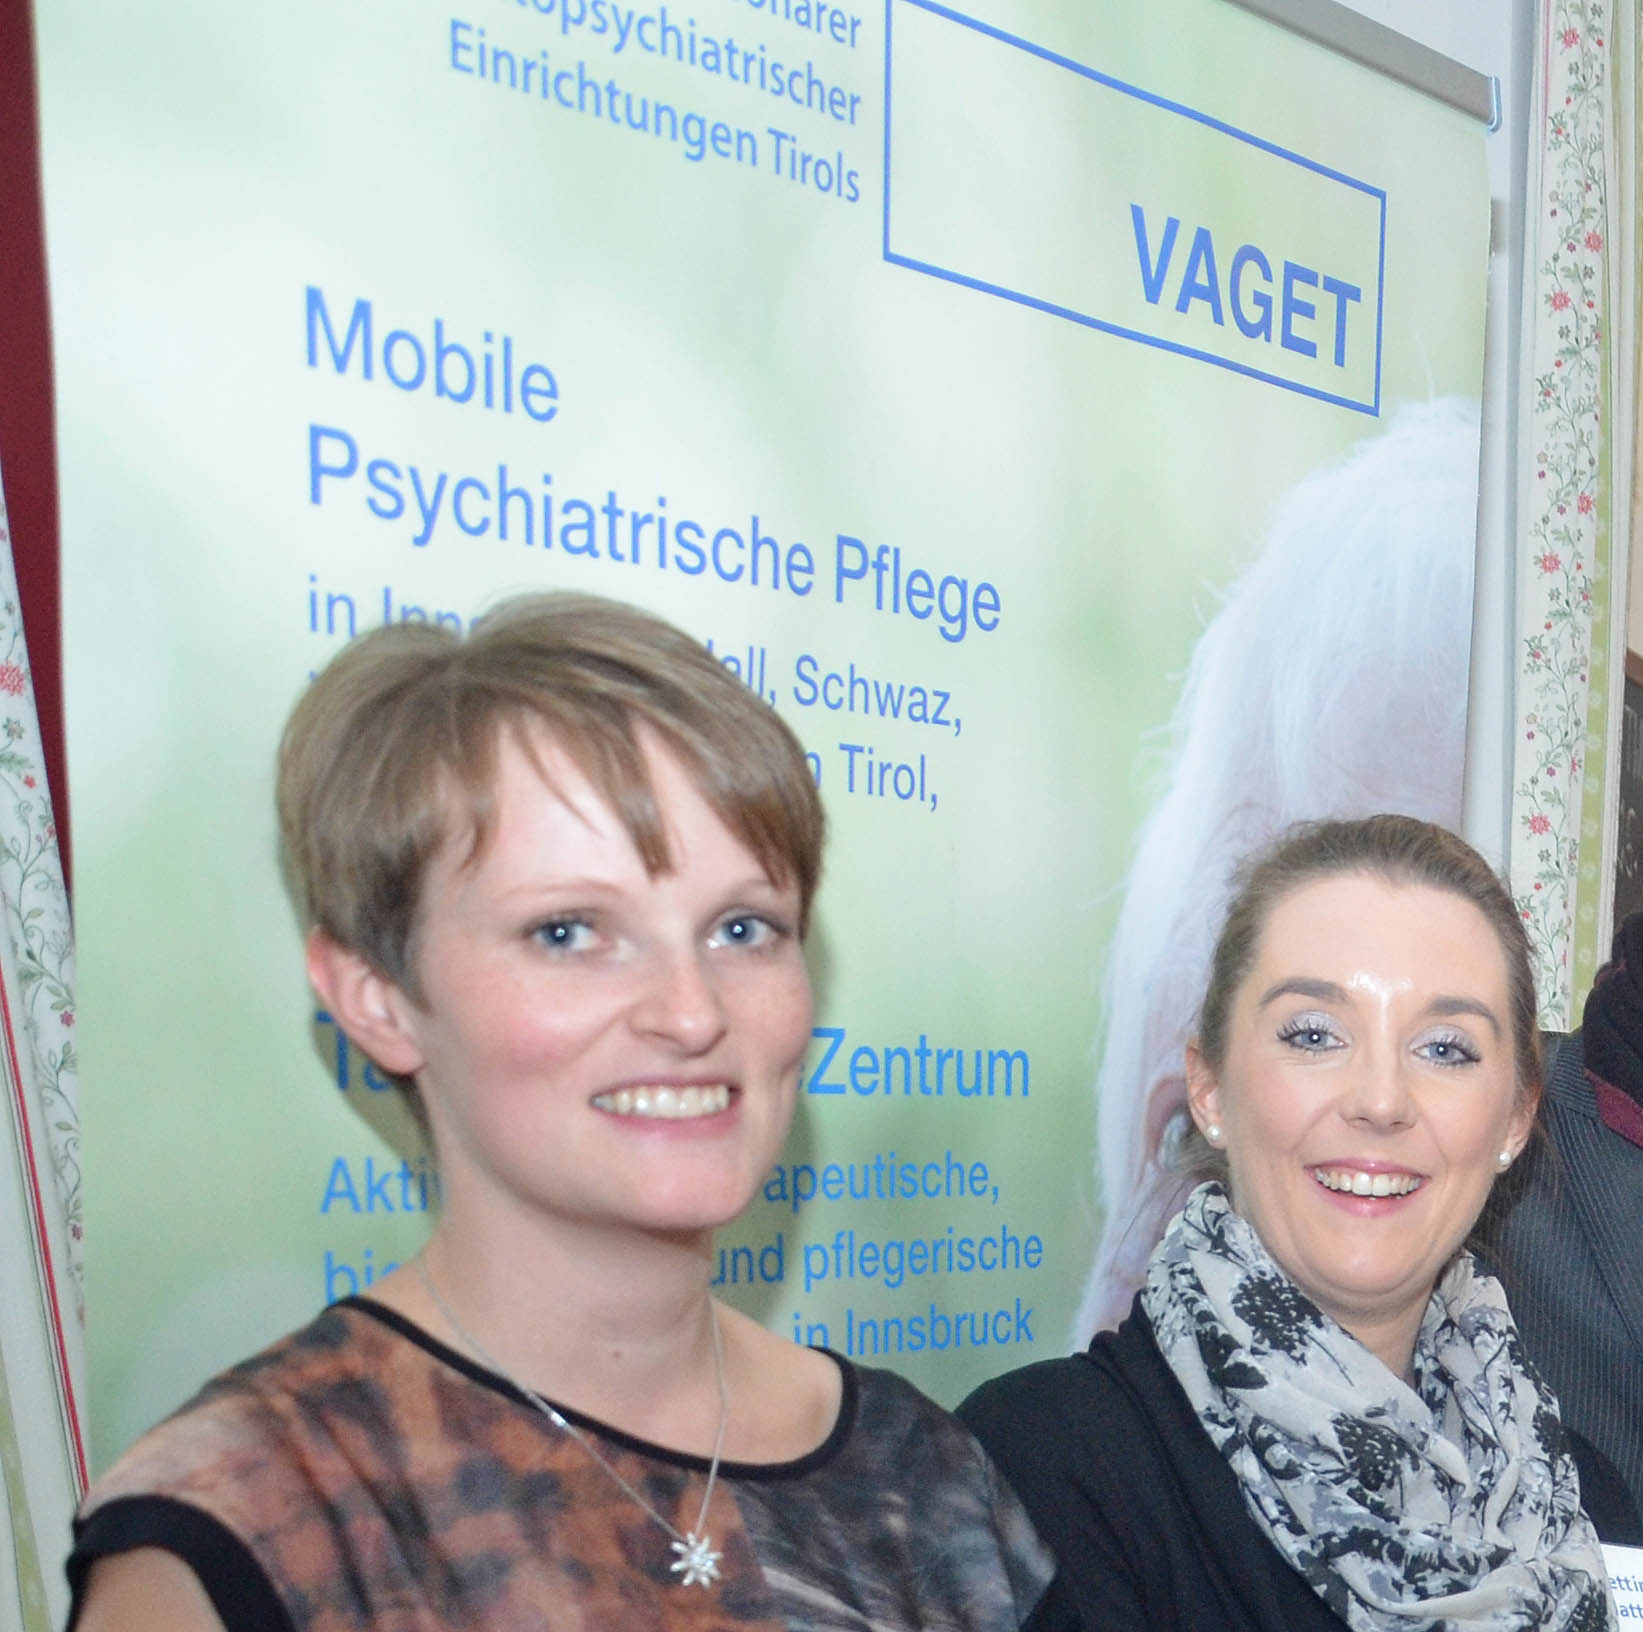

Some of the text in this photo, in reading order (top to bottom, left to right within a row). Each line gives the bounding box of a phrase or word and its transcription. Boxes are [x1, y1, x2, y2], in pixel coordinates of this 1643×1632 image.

[449, 17, 860, 203] Einrichtungen Tirols
[1129, 202, 1362, 368] VAGET
[306, 284, 559, 423] Mobile
[308, 422, 1001, 644] Psychiatrische Pflege
[308, 573, 357, 639] in
[793, 654, 963, 737] Schwaz,
[838, 742, 938, 812] Tirol,
[800, 1026, 1030, 1097] Zentrum
[763, 1150, 1000, 1213] apeutische,
[803, 1224, 1044, 1294] pflegerische
[793, 1298, 1035, 1356] in Innsbruck
